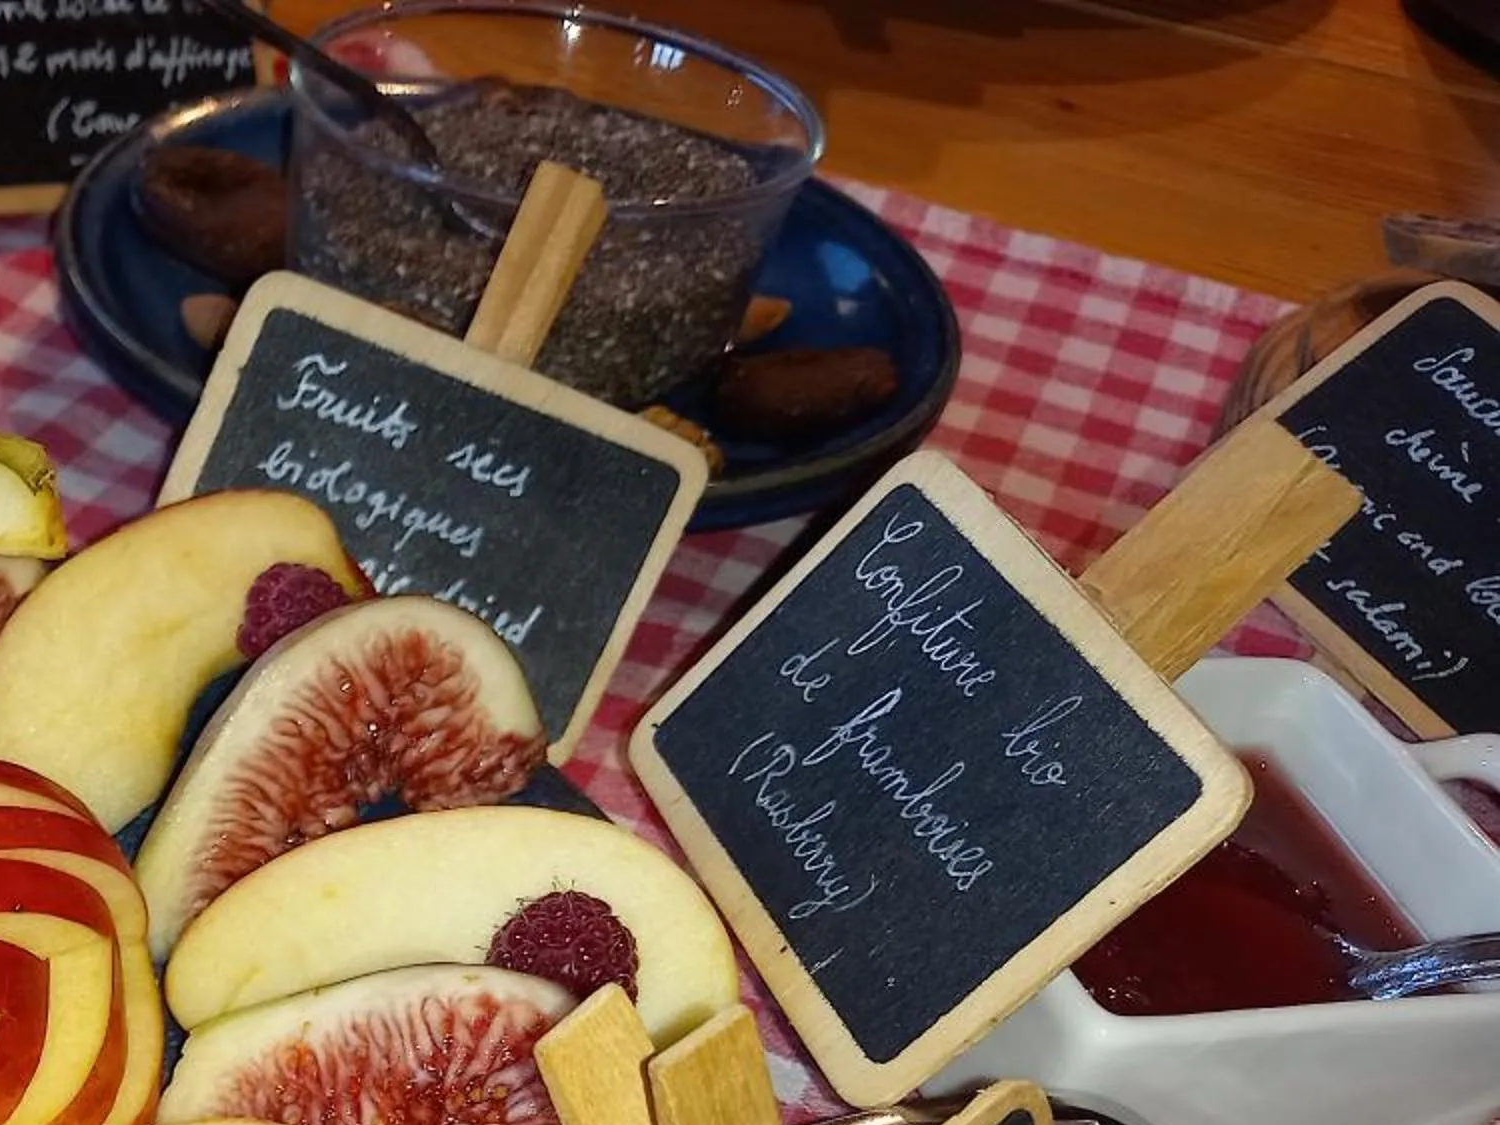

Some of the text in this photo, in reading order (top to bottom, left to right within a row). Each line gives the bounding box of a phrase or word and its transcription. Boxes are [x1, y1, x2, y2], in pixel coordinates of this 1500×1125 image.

[46, 40, 115, 77] mois
[277, 352, 537, 497] Fruits secs
[257, 441, 485, 559] biologiques
[1397, 528, 1463, 576] and
[848, 513, 1083, 787] Confiture bio
[780, 638, 993, 892] de framboises
